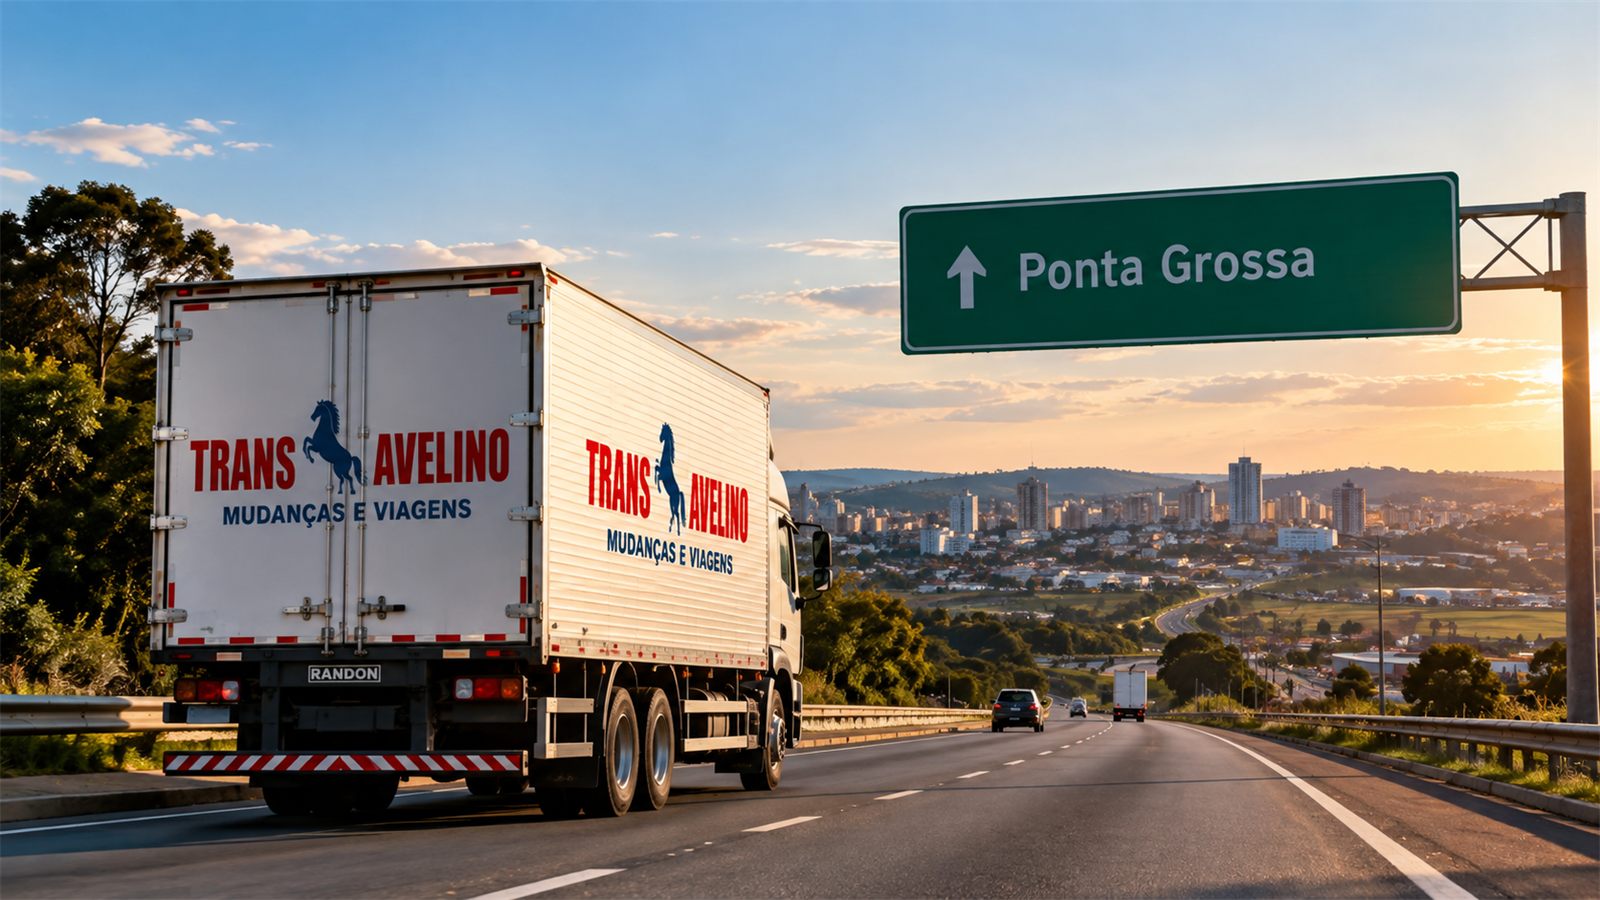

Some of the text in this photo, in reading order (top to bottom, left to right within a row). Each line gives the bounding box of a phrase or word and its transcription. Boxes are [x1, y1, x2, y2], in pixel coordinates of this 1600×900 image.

[1020, 243, 1315, 291] Ponta Grossa
[190, 428, 509, 492] TRANS AVELINO
[222, 498, 472, 528] MUDANÇAS E VIAGENS
[586, 438, 749, 543] TRANS AVELINO
[607, 528, 733, 575] MUDANÇAS E VIAGENS
[310, 667, 378, 681] RANDON
